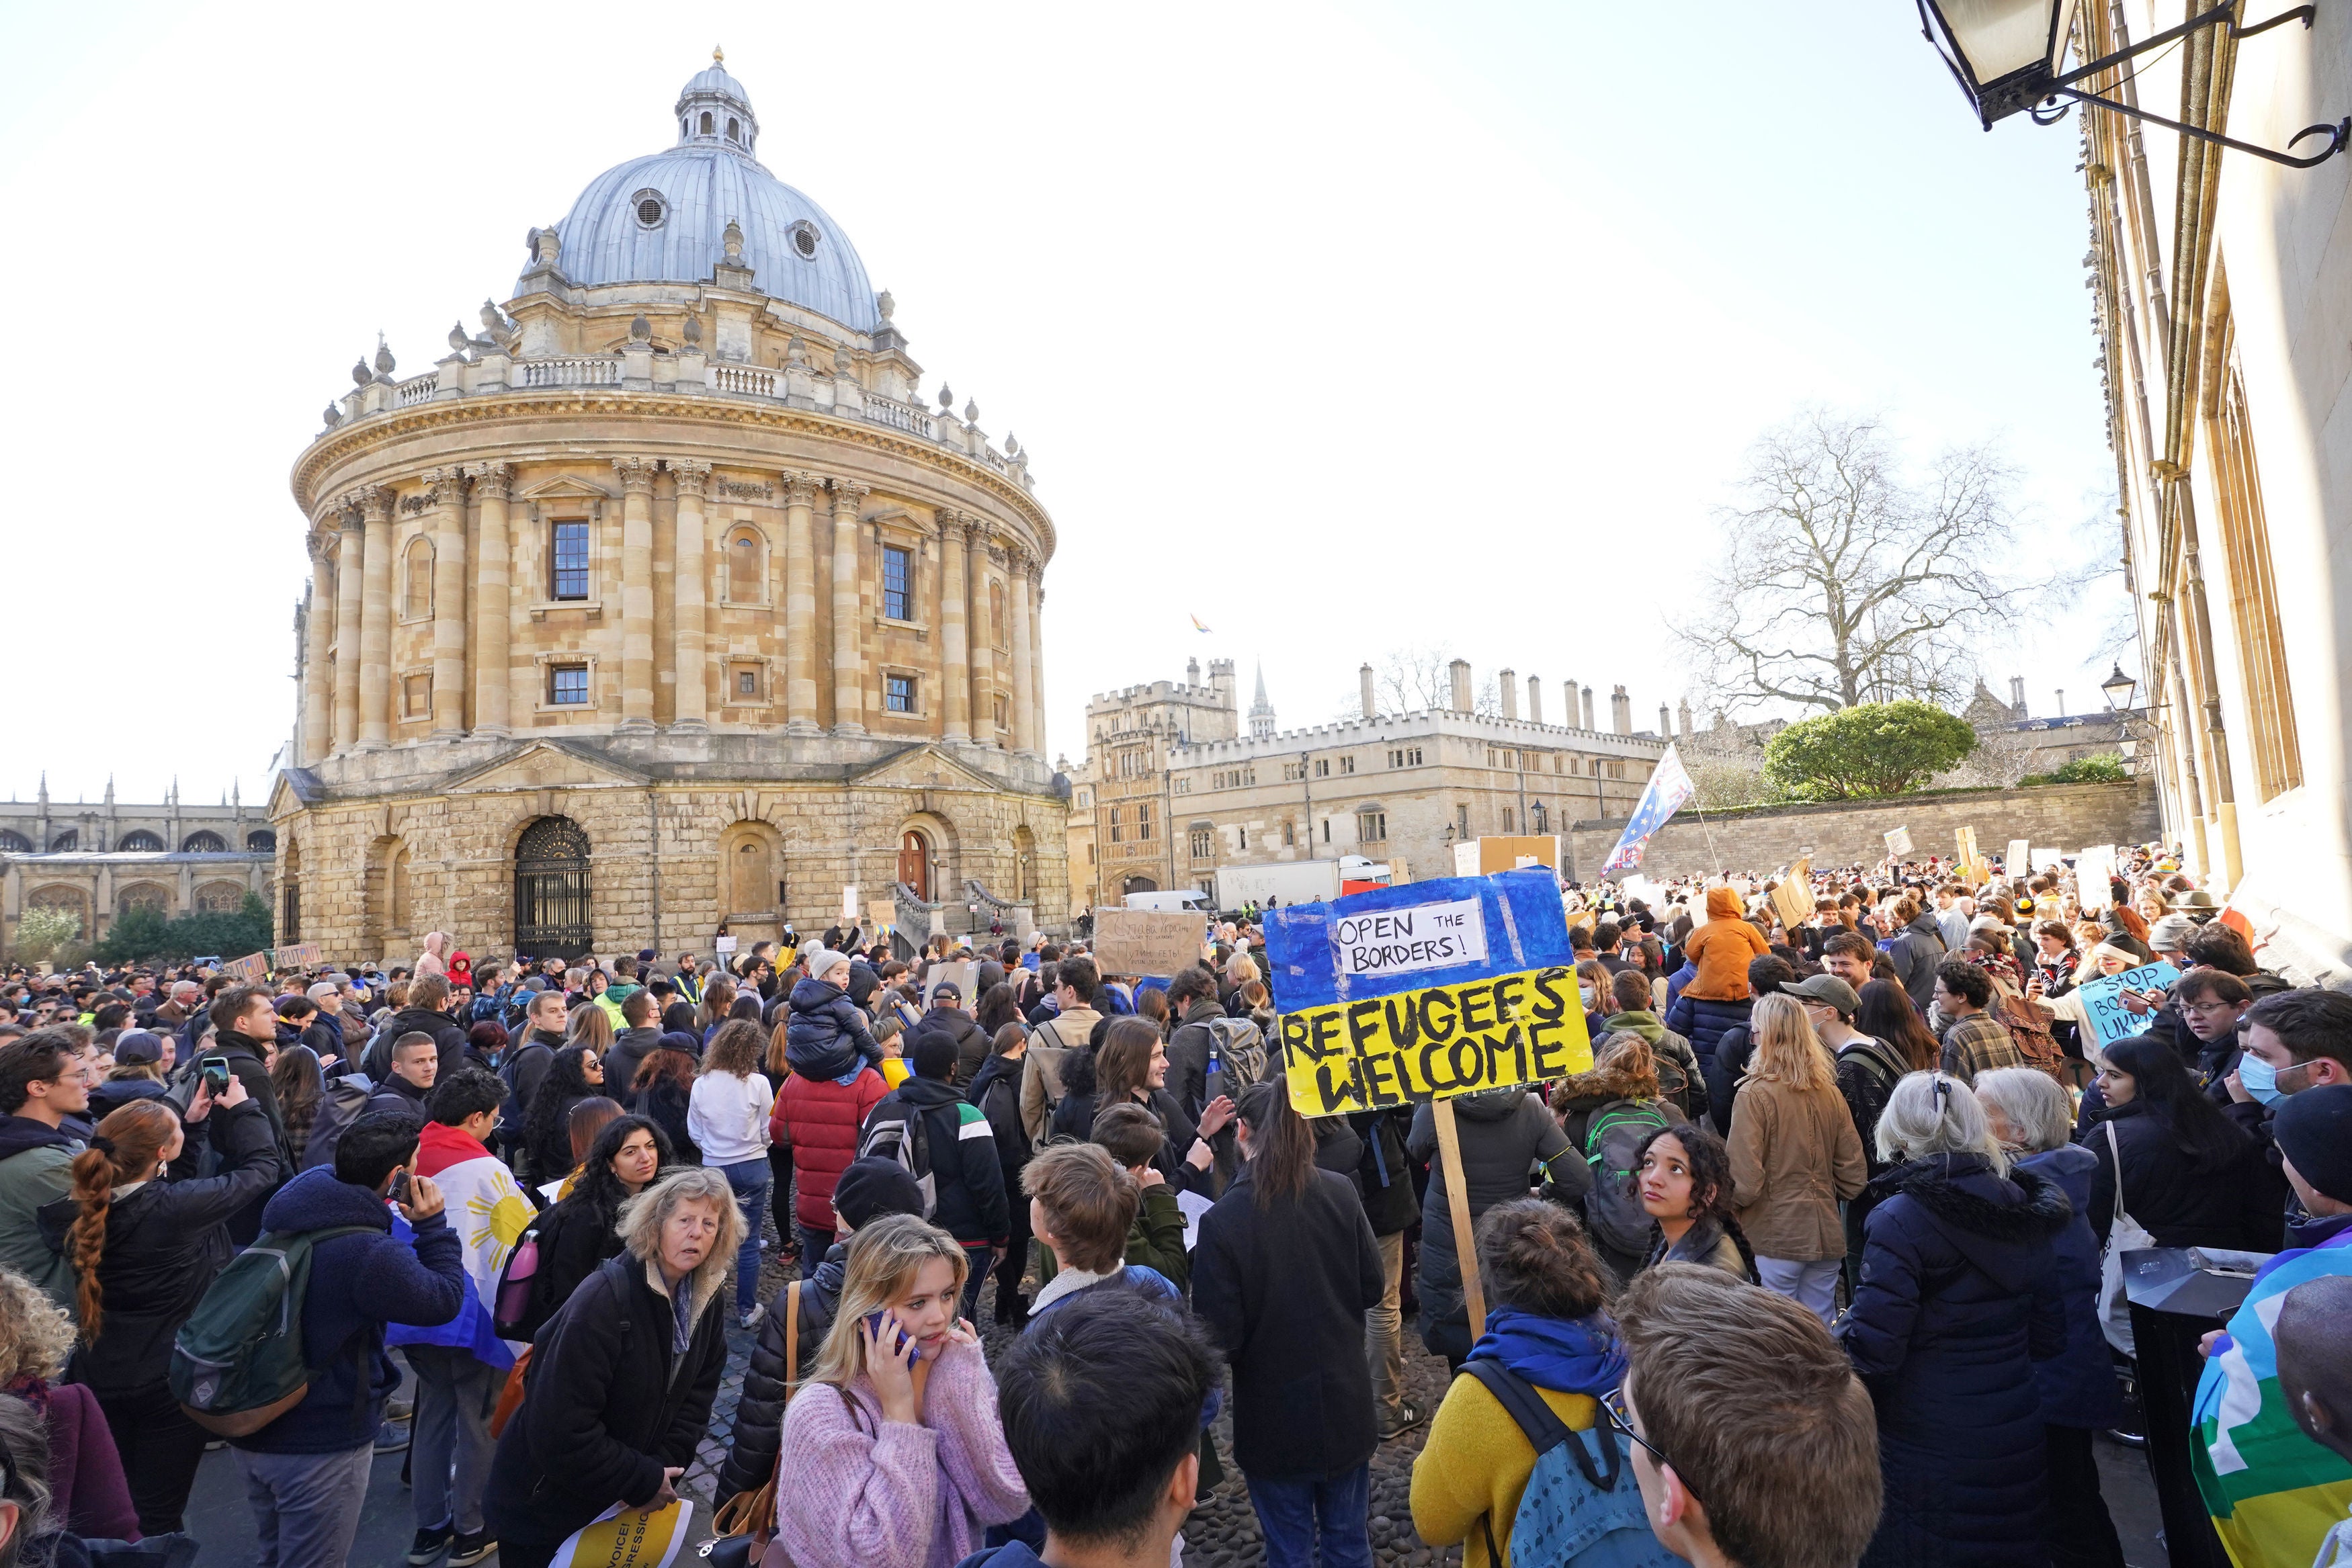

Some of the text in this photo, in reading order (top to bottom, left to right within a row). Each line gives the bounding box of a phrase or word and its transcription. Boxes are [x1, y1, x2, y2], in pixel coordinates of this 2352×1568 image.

[1338, 911, 1464, 945] OPEN THE
[1351, 934, 1467, 972] BORDERS!
[1281, 967, 1569, 1068] REFUGEES
[1315, 1019, 1568, 1113] WELCOME
[1404, 1409, 1413, 1421] N
